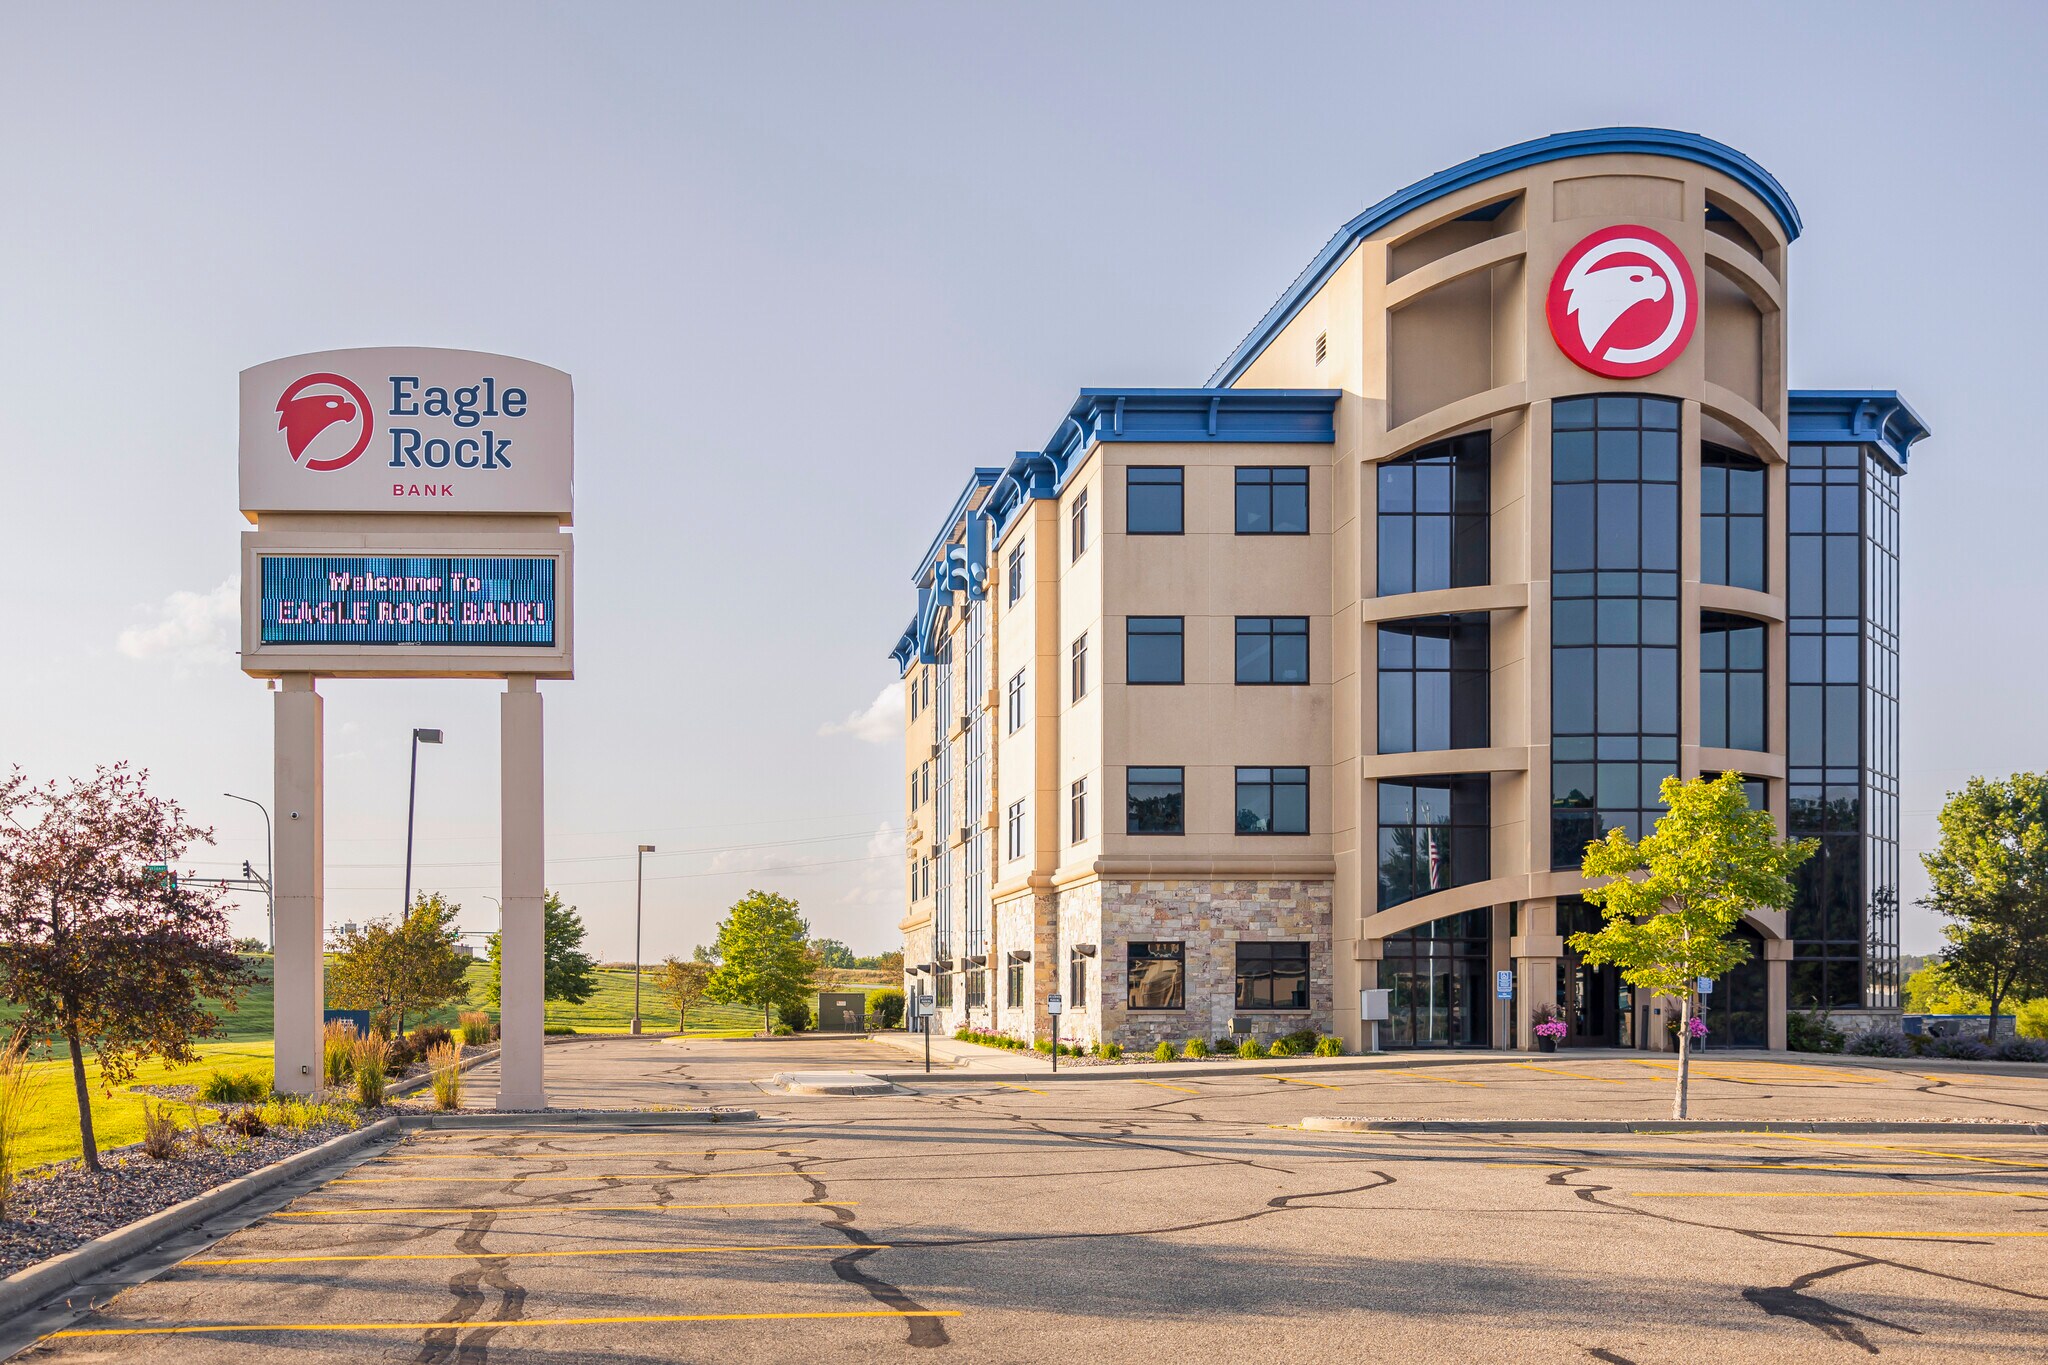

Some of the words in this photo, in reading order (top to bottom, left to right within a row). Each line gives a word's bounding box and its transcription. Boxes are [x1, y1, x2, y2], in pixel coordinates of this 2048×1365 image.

[388, 376, 528, 428] Eagle
[388, 427, 513, 470] Rock
[393, 484, 454, 497] BANK
[329, 572, 442, 591] Welcome
[451, 572, 481, 591] To
[278, 601, 369, 624] EAGLE
[377, 602, 454, 625] ROCK
[462, 602, 545, 625] BANK!
